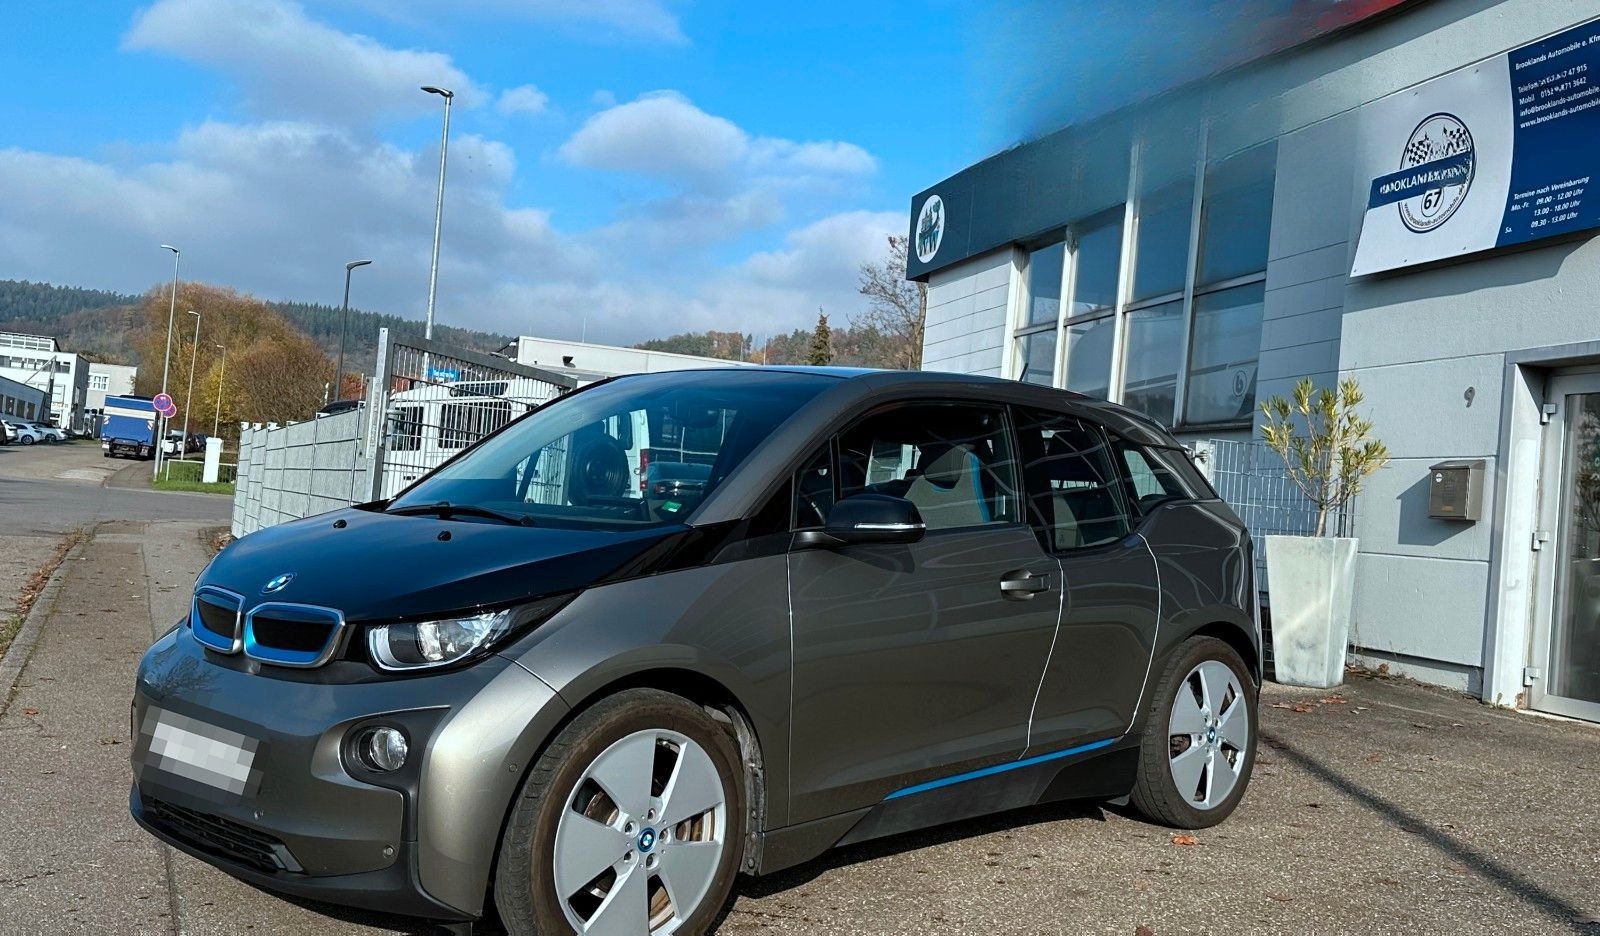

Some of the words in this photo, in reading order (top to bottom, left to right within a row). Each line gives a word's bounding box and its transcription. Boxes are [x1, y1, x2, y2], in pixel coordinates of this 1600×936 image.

[1515, 54, 1547, 70] Brooklands
[1547, 42, 1581, 59] Automobile
[1514, 190, 1535, 200] Termine
[1536, 186, 1550, 195] nach
[1551, 176, 1590, 191] Vereinbarung
[1557, 190, 1572, 200] 12.00
[1572, 188, 1584, 197] Uhr
[1423, 189, 1442, 210] 67
[1534, 207, 1550, 216] 13.00
[1569, 199, 1581, 208] Uhr
[1566, 211, 1578, 220] Uhr
[1464, 386, 1475, 408] 9
